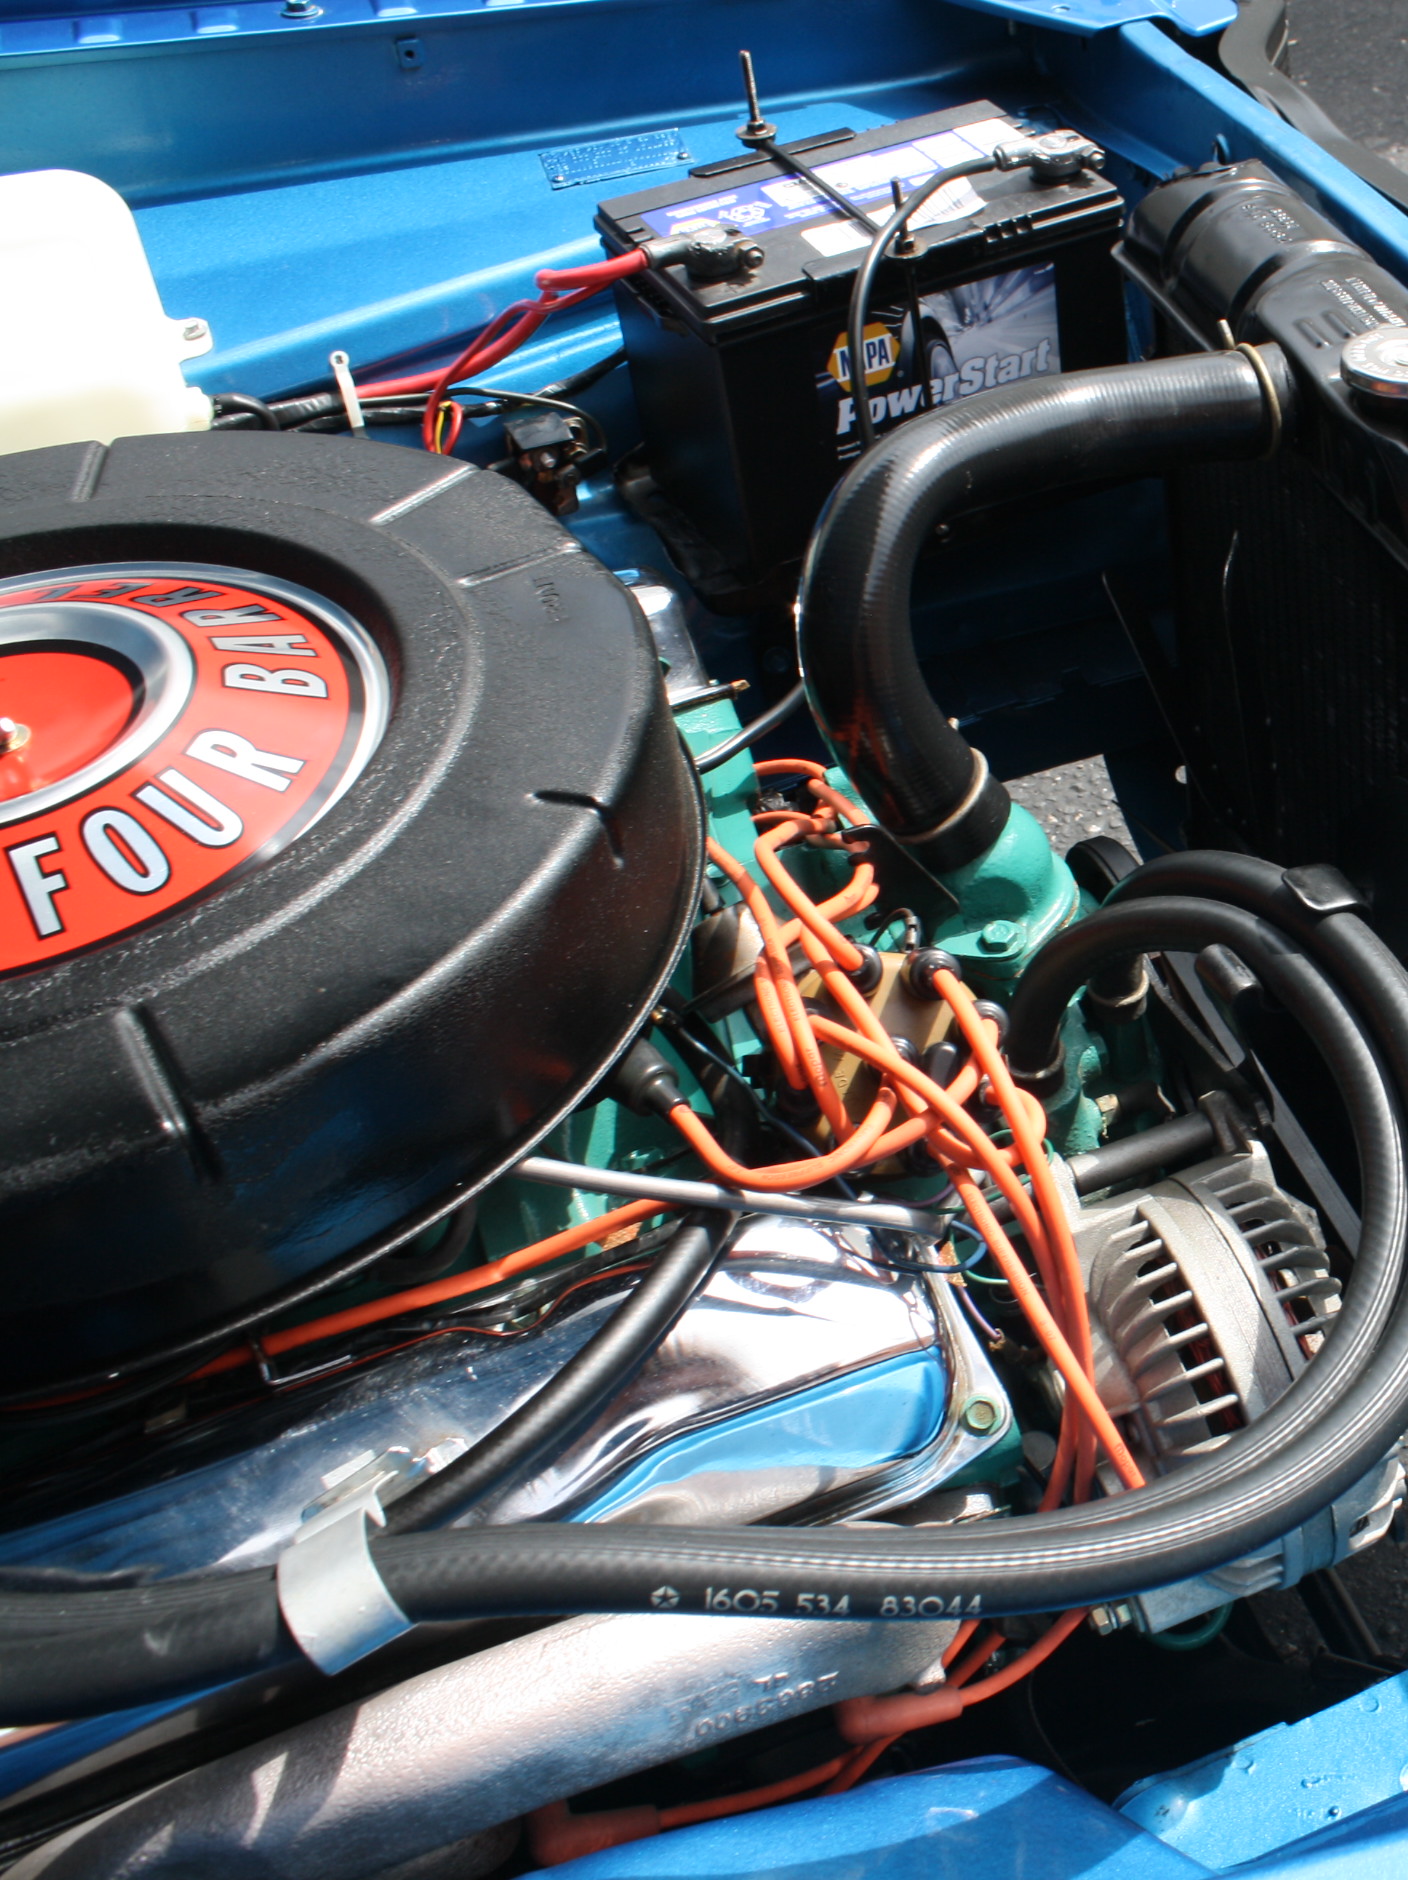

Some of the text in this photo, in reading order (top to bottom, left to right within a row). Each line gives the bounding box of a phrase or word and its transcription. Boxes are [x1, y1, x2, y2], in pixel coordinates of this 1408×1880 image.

[837, 338, 892, 378] NPA
[4, 582, 329, 939] FOUR BARREL
[966, 1192, 994, 1236] ELECTRONIC
[704, 1586, 982, 1617] 1605 534 83044
